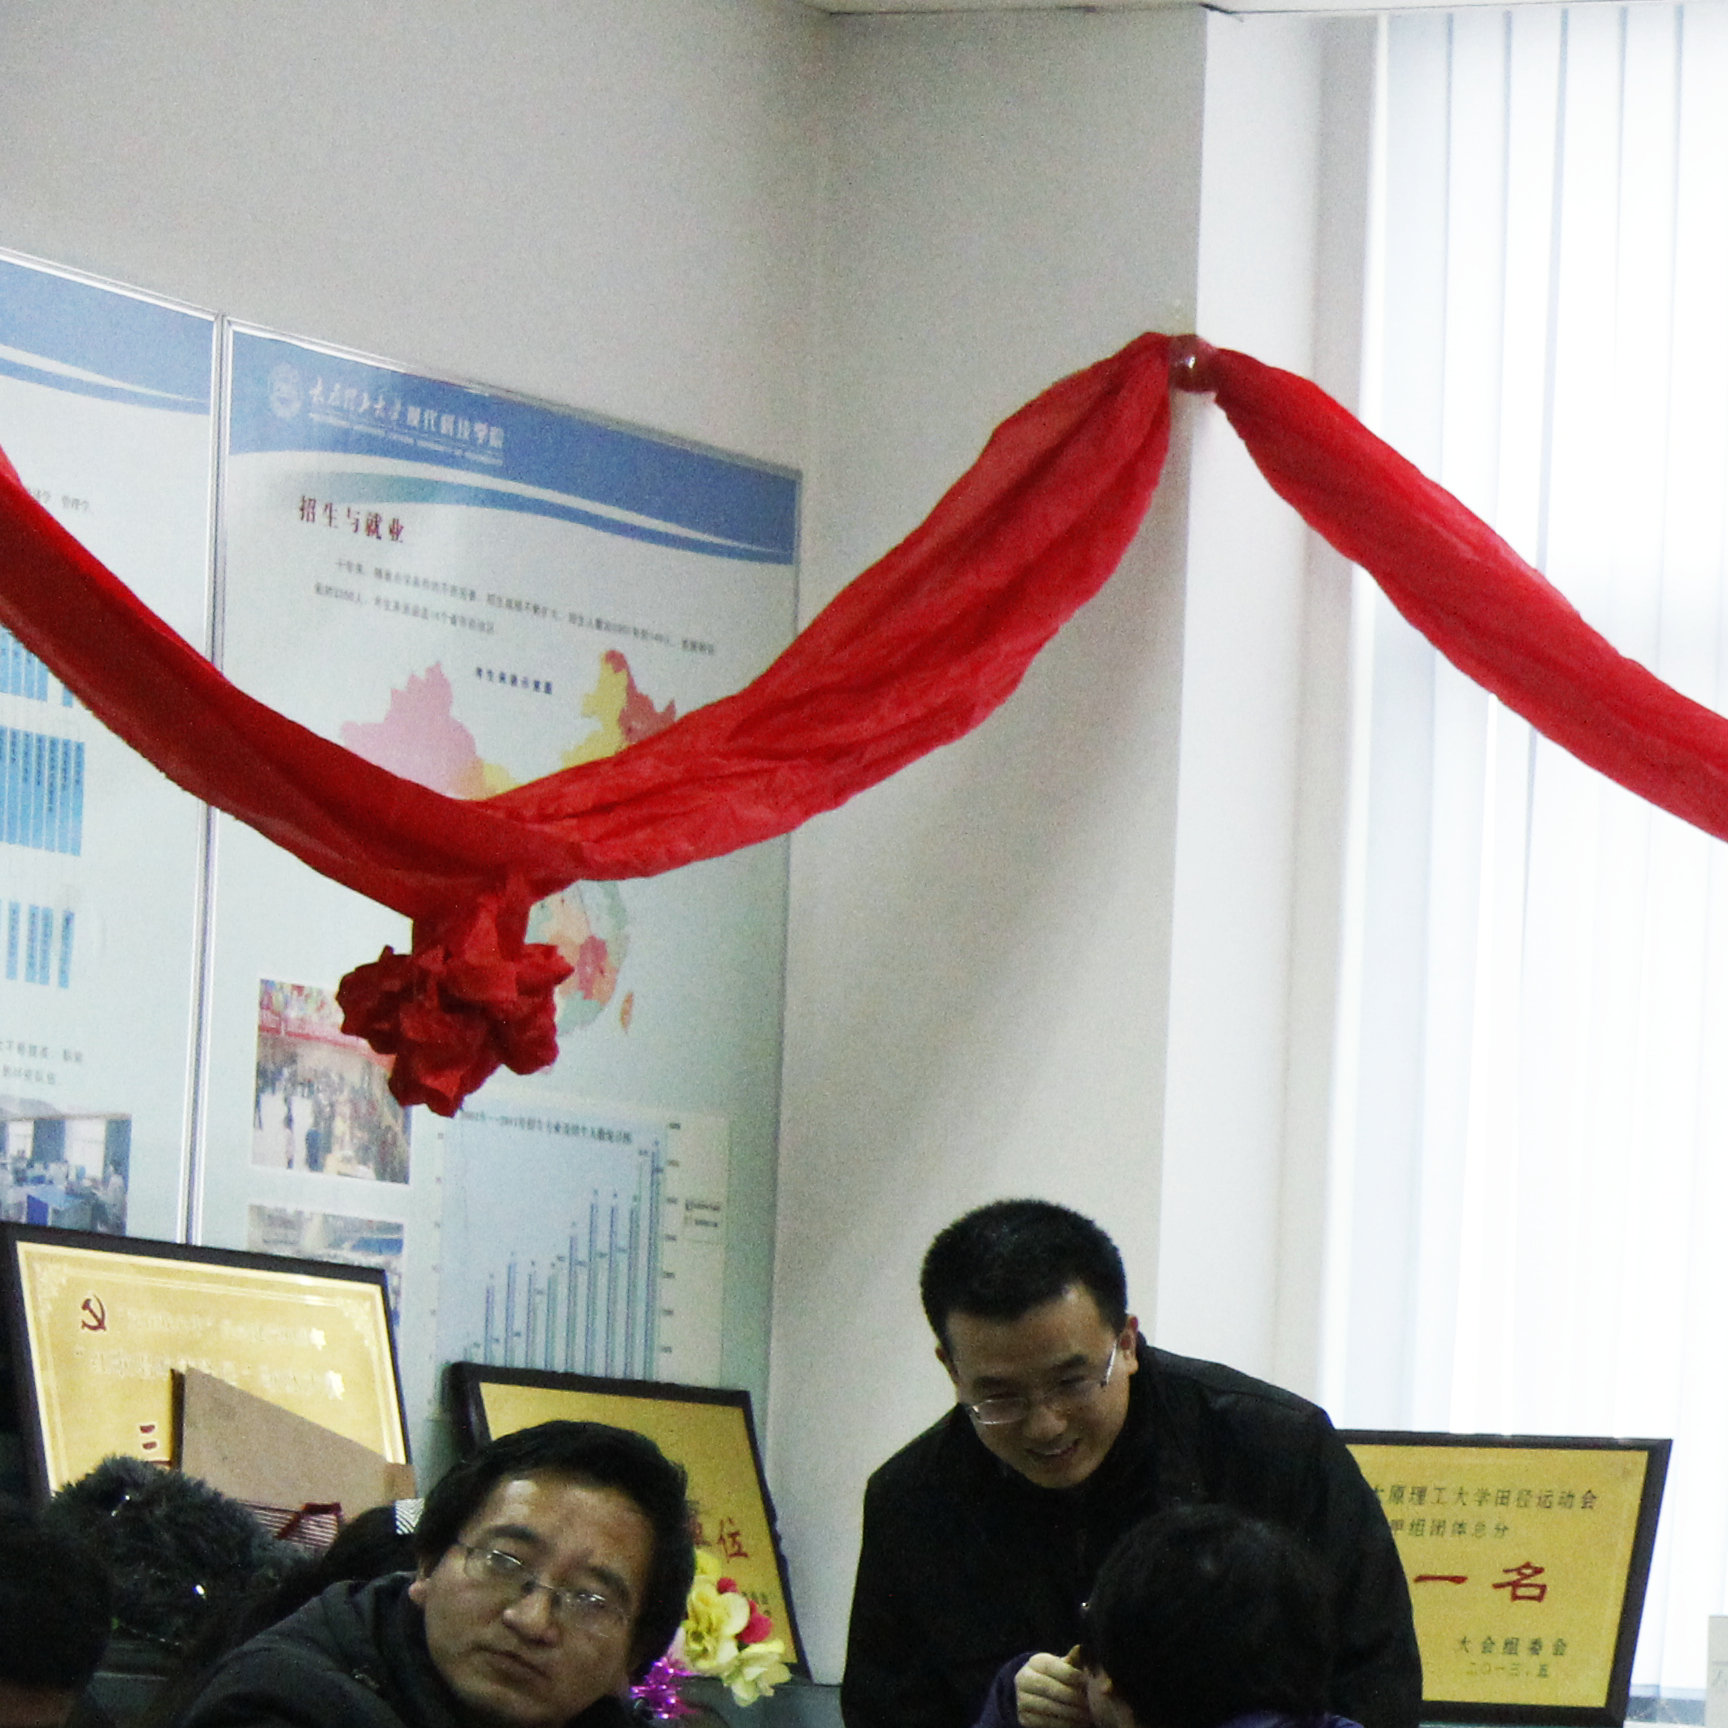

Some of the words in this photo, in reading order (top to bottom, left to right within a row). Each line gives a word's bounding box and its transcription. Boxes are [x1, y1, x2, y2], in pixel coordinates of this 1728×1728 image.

[300, 495, 404, 543] 招生与就业
[1460, 1636, 1568, 1656] 大会组委会
